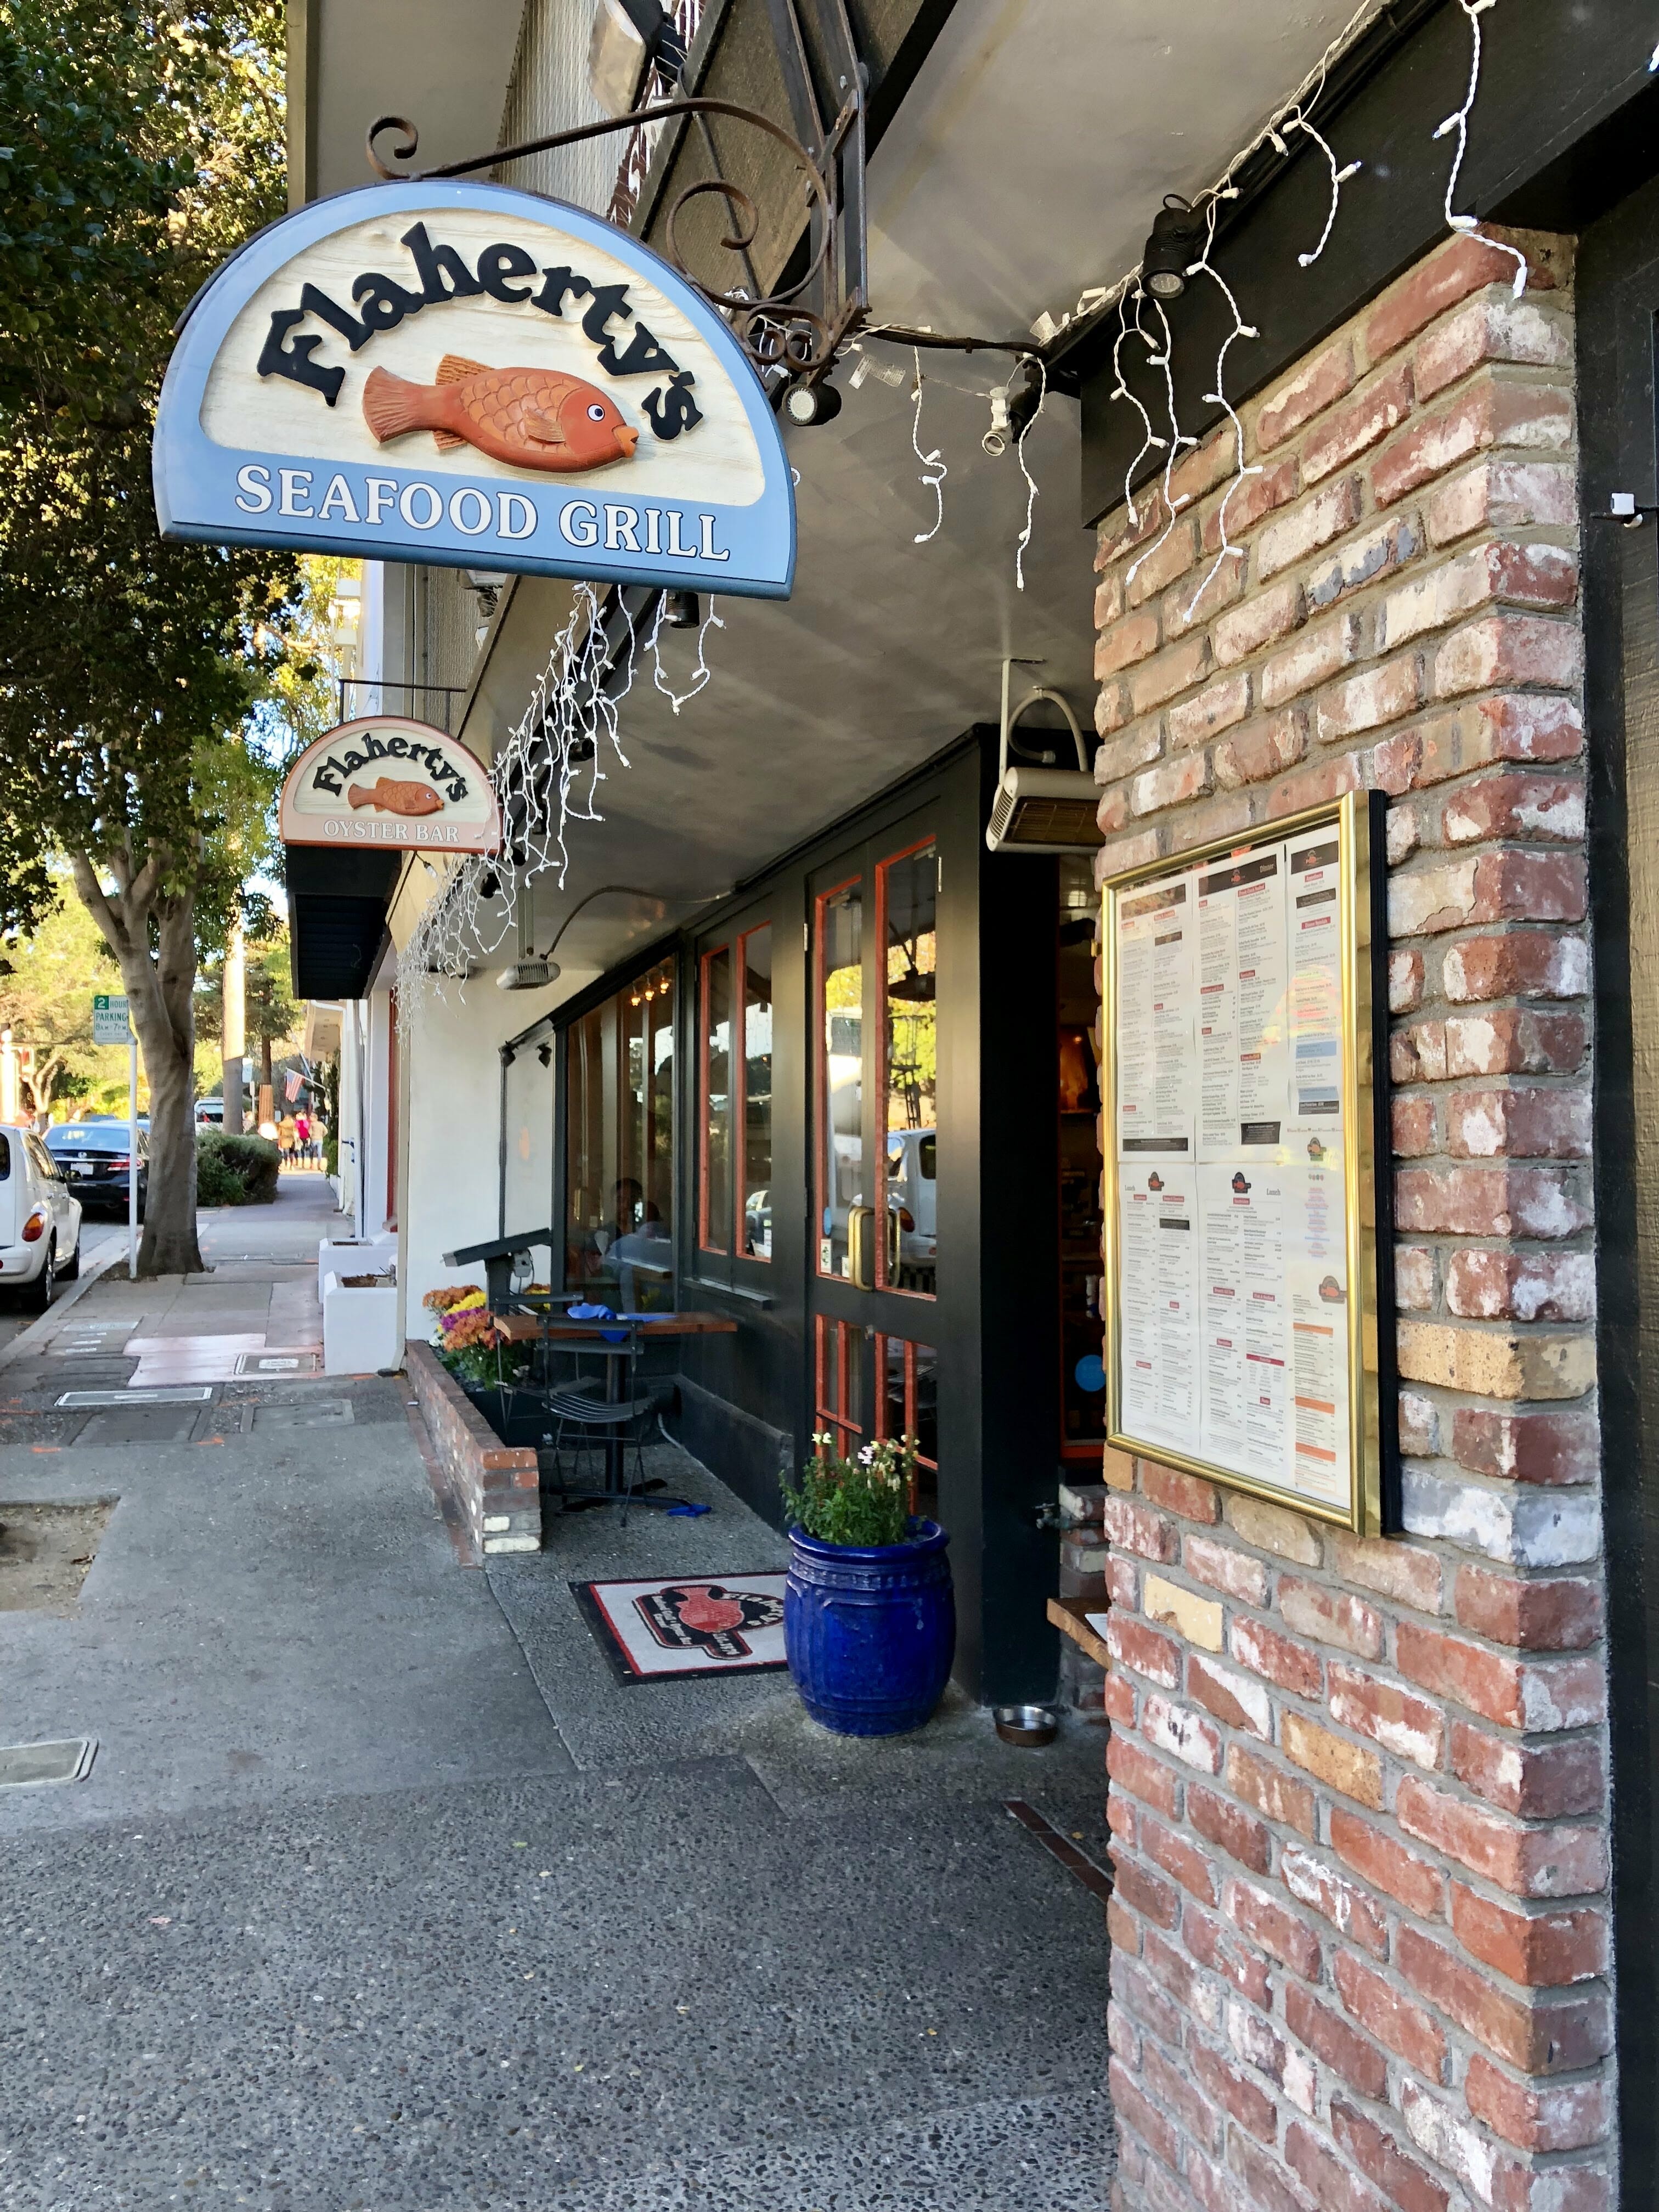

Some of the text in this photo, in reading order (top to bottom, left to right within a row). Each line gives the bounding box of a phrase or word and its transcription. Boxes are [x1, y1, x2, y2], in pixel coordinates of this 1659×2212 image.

[257, 221, 703, 441] Flaherty's
[234, 463, 731, 561] SEAFOOD GRILL
[313, 732, 469, 802] Flaherty's
[324, 820, 460, 843] OYSTER BAR
[96, 1012, 126, 1022] PARKING
[98, 997, 127, 1008] 2 HOUR
